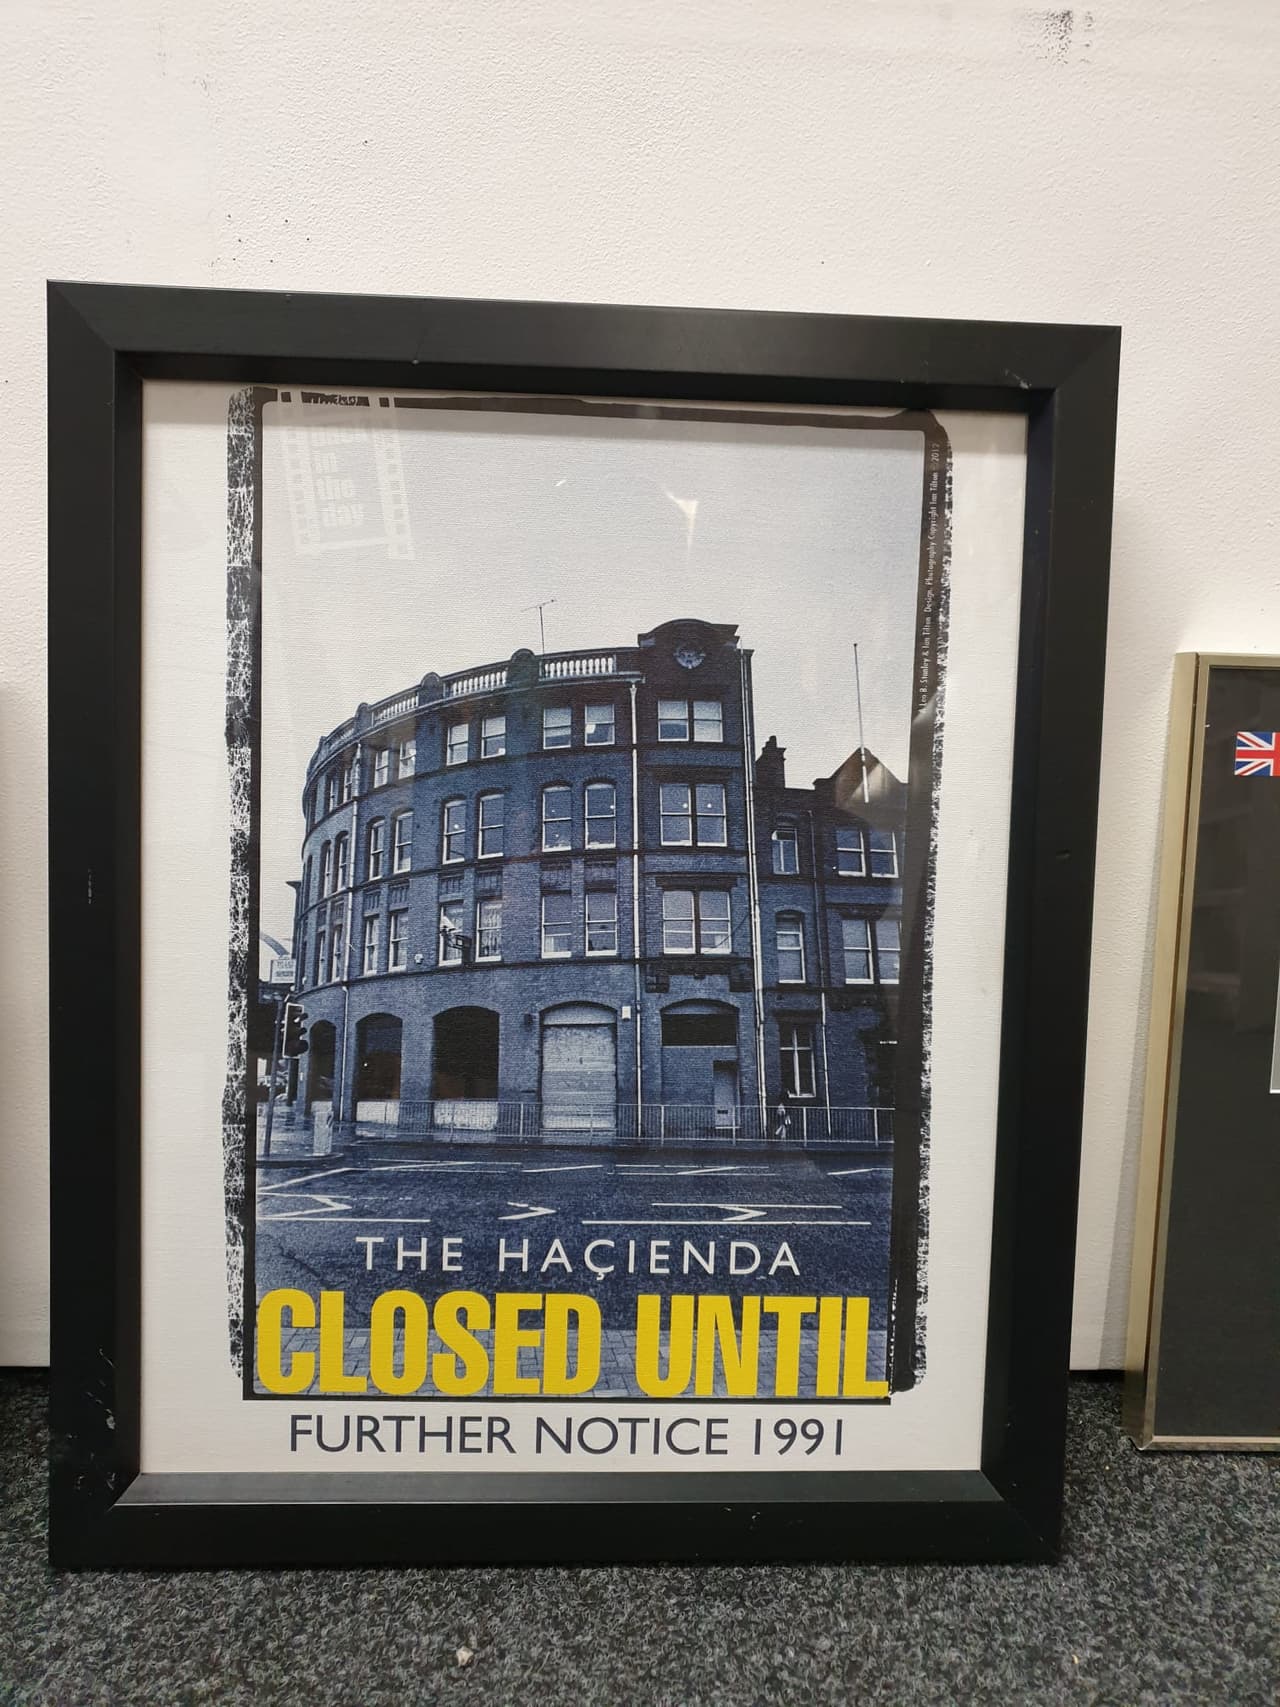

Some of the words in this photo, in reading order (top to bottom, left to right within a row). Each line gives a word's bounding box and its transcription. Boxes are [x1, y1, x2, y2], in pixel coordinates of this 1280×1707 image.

[930, 472, 939, 492] Tilton
[927, 506, 939, 540] Copyright
[924, 541, 937, 585] Photography
[919, 658, 930, 684] Stanley
[355, 1236, 464, 1272] THE
[499, 1238, 802, 1281] HAÇIENDA
[256, 1289, 603, 1397] CLOSED
[636, 1294, 890, 1399] UNTIL
[291, 1414, 516, 1454] FURTHER
[535, 1416, 729, 1455] NOTICE
[754, 1418, 843, 1456] 1991
